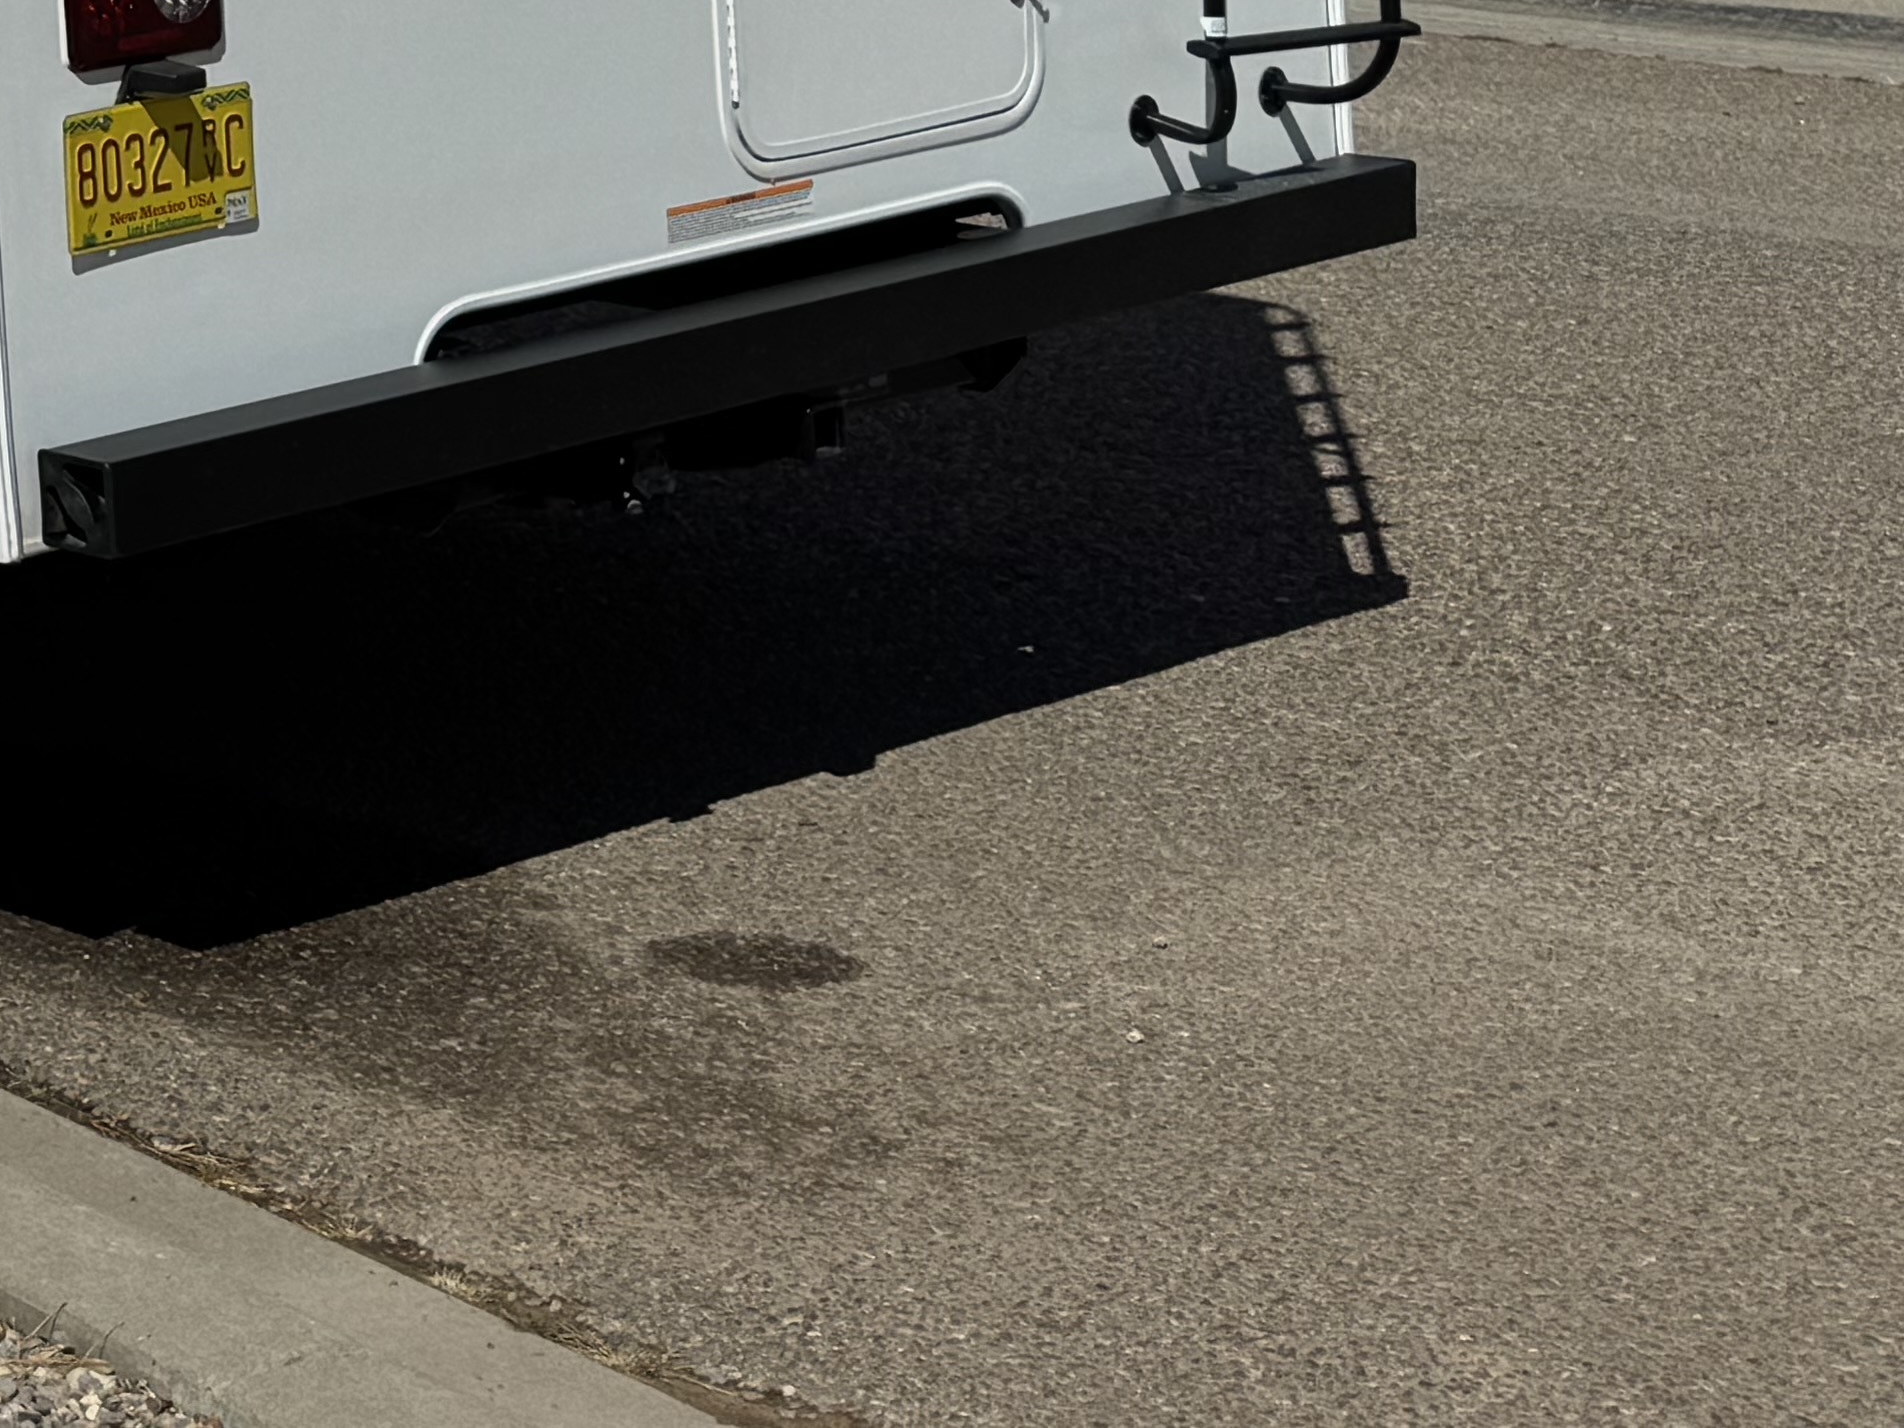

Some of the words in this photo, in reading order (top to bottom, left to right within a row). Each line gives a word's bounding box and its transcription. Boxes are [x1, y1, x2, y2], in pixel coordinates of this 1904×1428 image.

[109, 212, 138, 227] New
[139, 200, 186, 220] Mexico
[188, 191, 217, 209] USA
